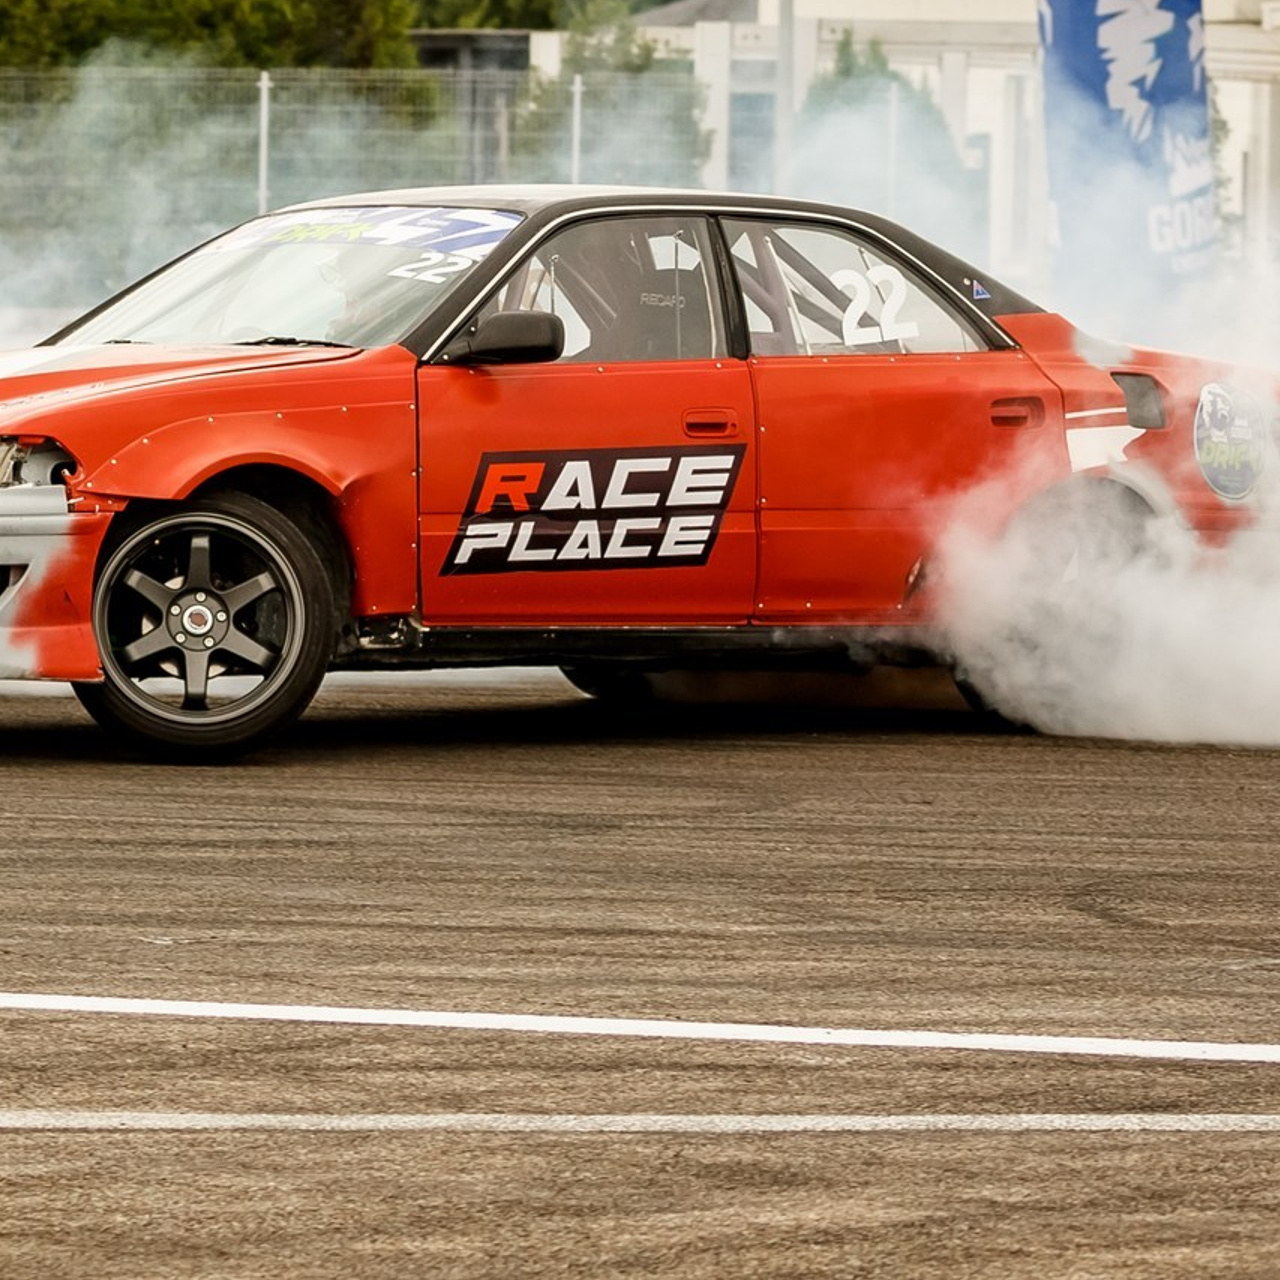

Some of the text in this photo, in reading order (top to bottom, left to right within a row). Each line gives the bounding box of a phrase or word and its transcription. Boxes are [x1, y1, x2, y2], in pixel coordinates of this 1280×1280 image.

[387, 248, 473, 284] 22
[830, 264, 919, 346] 22
[474, 455, 735, 512] RACE
[454, 515, 715, 564] PLACE
